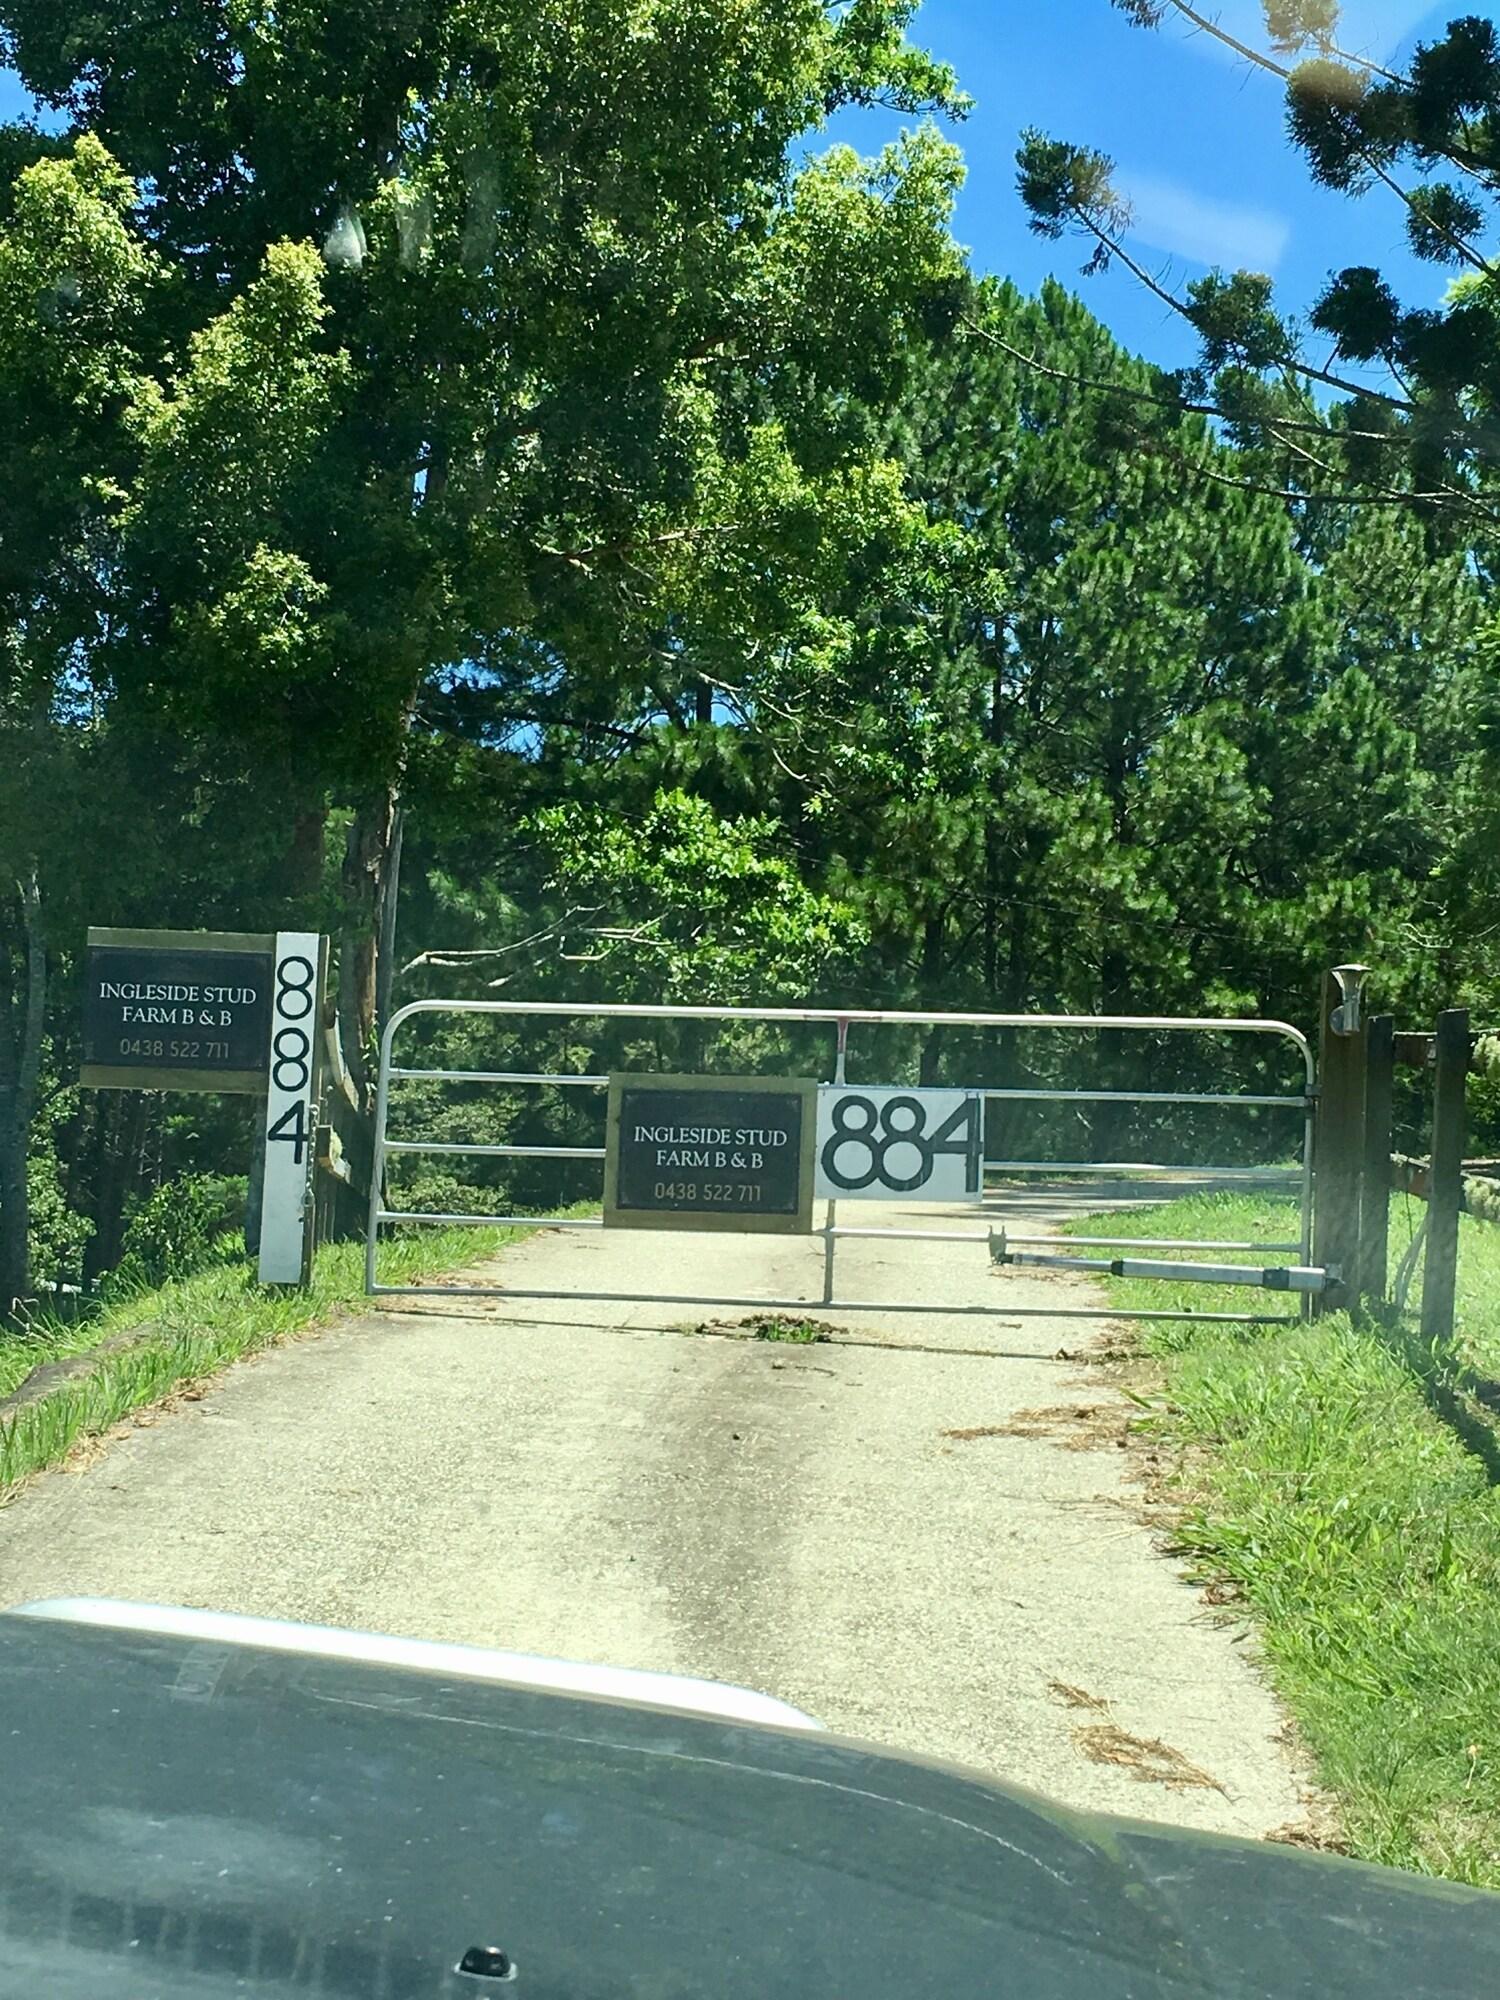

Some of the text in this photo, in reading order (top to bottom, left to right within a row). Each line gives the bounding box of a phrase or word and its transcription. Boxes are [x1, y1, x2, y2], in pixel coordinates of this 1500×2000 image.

[100, 982, 257, 1005] INGLESIDE STUD
[122, 1006, 232, 1027] FARM B & B
[119, 1038, 230, 1059] 0438 522 711
[267, 955, 315, 1165] 884
[633, 1125, 787, 1147] INGLESIDE STUD
[820, 1094, 984, 1193] 884
[656, 1149, 764, 1169] FARM B & B
[654, 1182, 761, 1201] 0438 522 711
